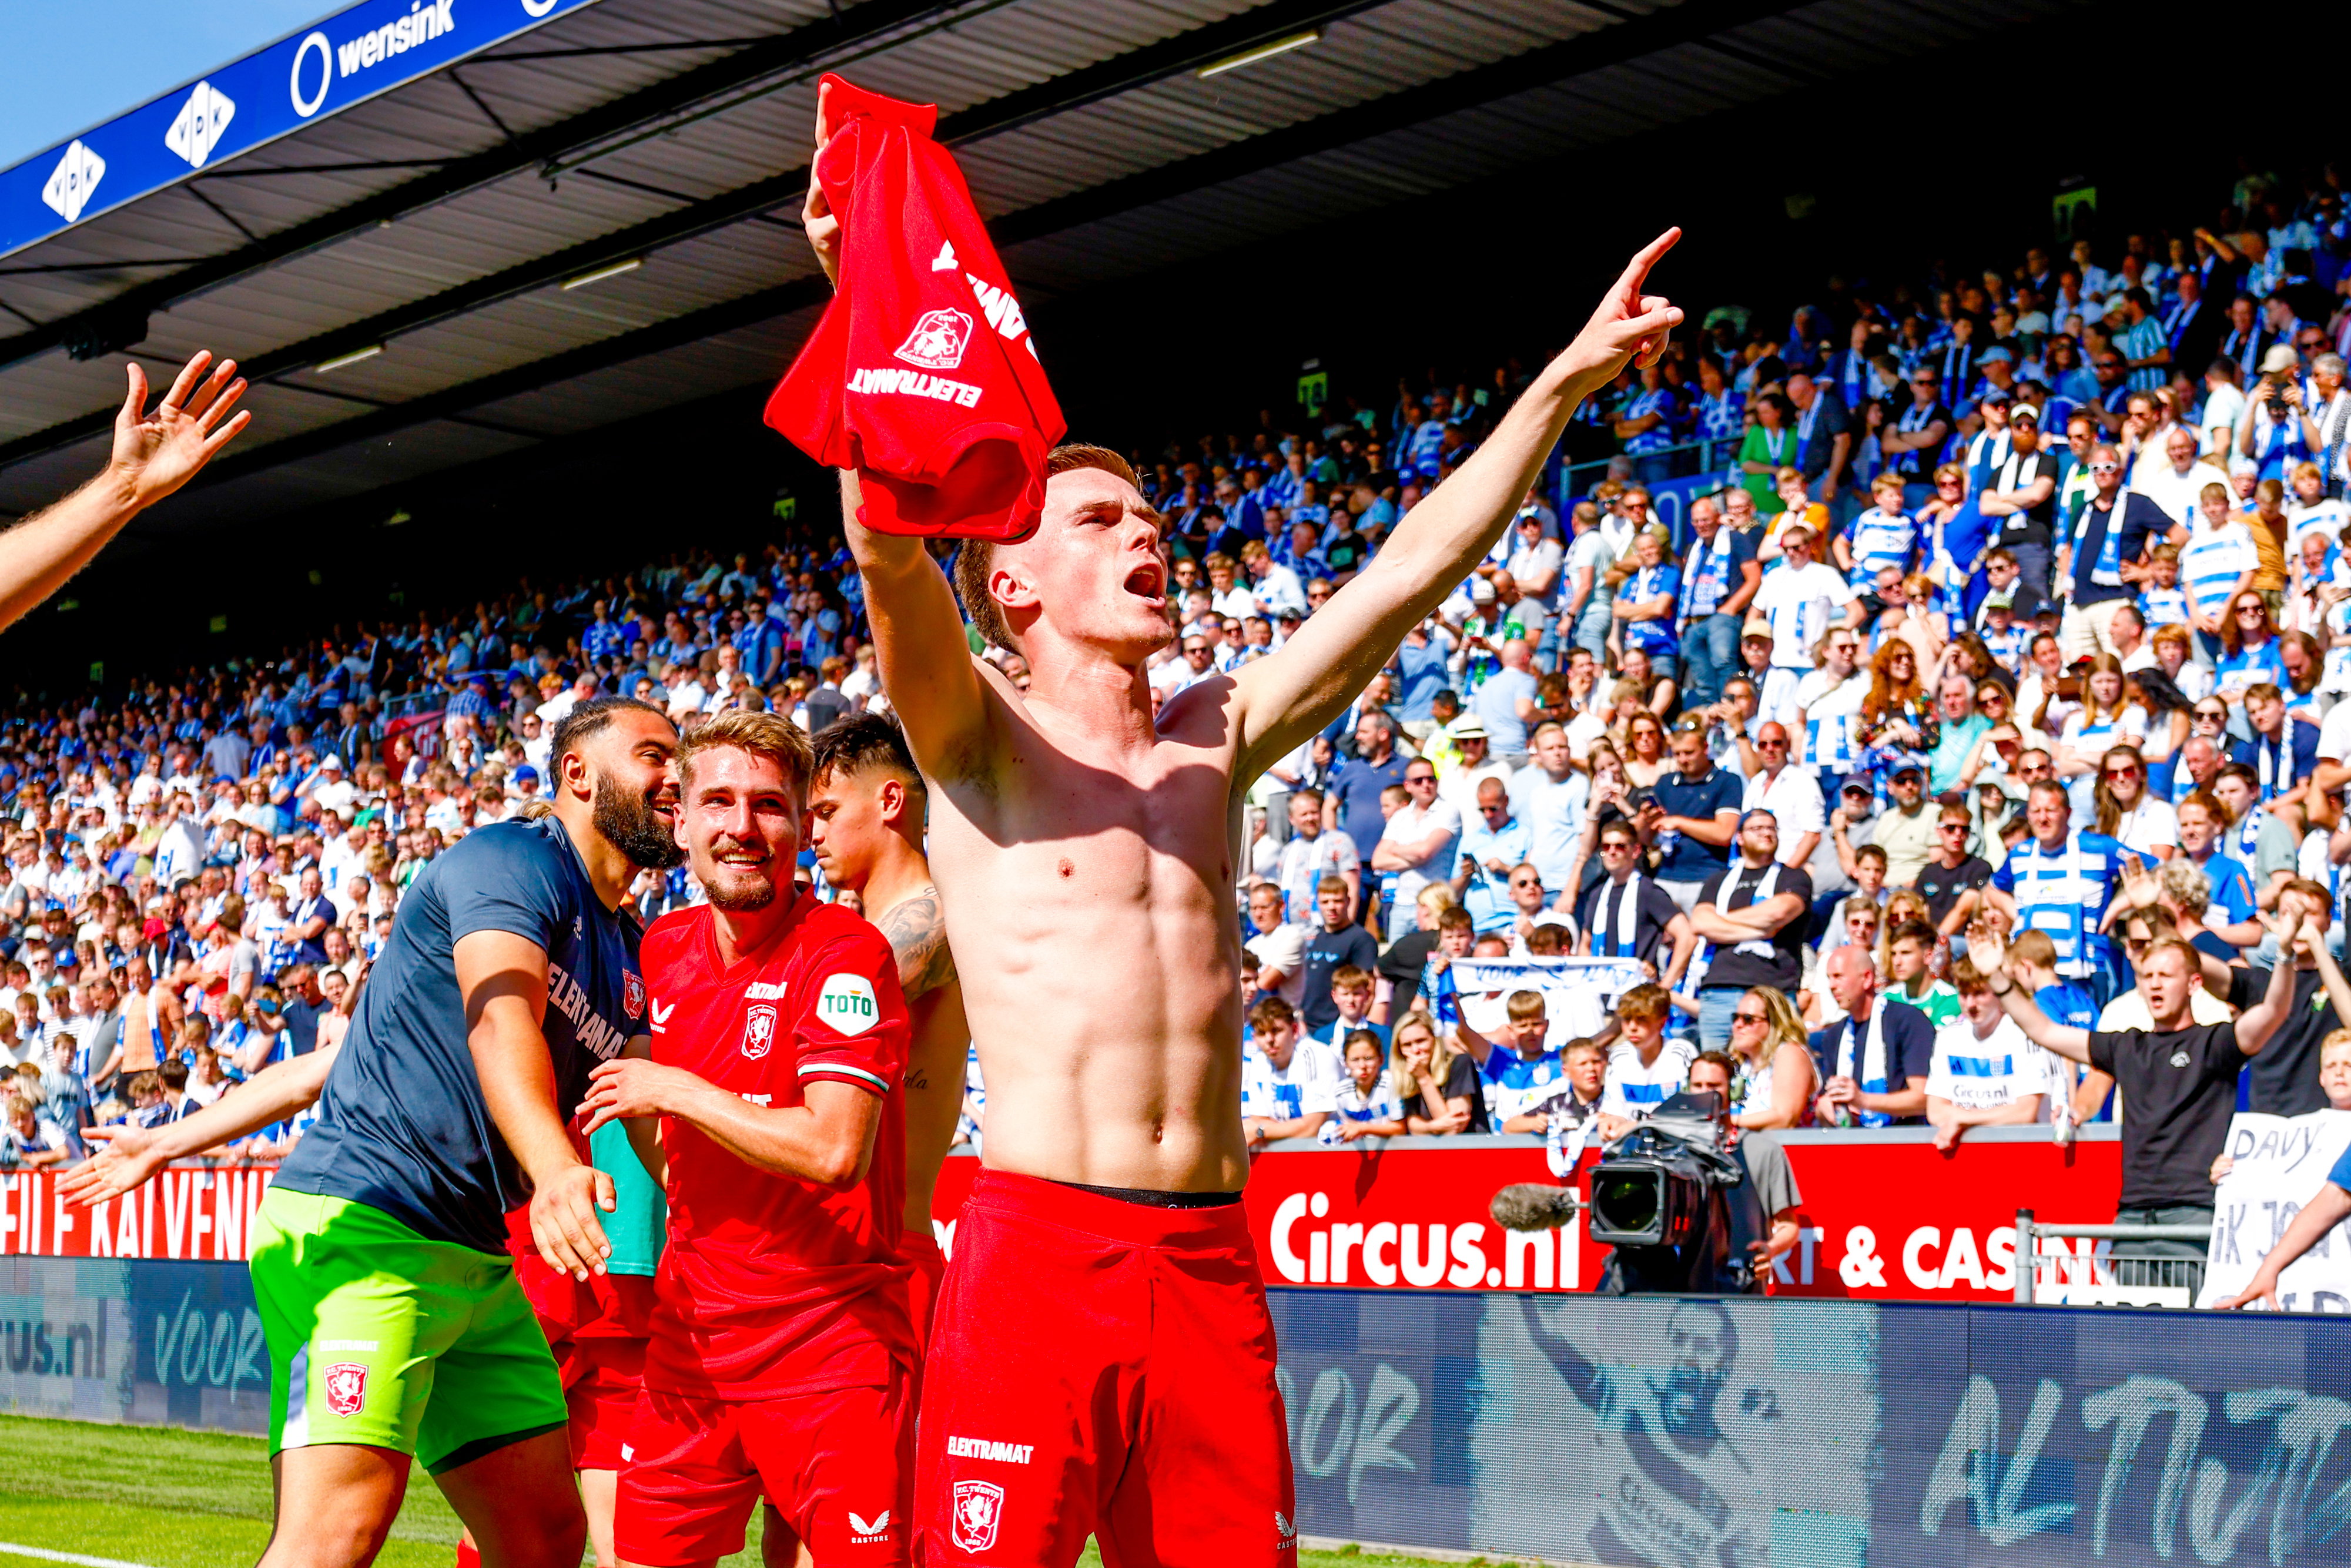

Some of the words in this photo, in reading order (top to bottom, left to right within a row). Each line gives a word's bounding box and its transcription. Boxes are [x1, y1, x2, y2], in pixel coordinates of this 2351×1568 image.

[337, 0, 455, 78] wensink
[178, 106, 222, 142] VDK
[54, 164, 93, 197] VDK
[846, 368, 983, 408] ELEKTRAMAT
[825, 994, 872, 1017] TOTO
[1270, 1192, 1580, 1289] Circus.nl
[1839, 1225, 1888, 1288] &
[155, 1287, 264, 1404] VOOR
[319, 1339, 379, 1352] ELEKTRAMAT
[337, 1365, 366, 1374] TWENTE
[947, 1436, 1034, 1464] ELEKTRAMAT
[969, 1485, 1000, 1499] TWENTE
[851, 1535, 889, 1543] CASTORE
